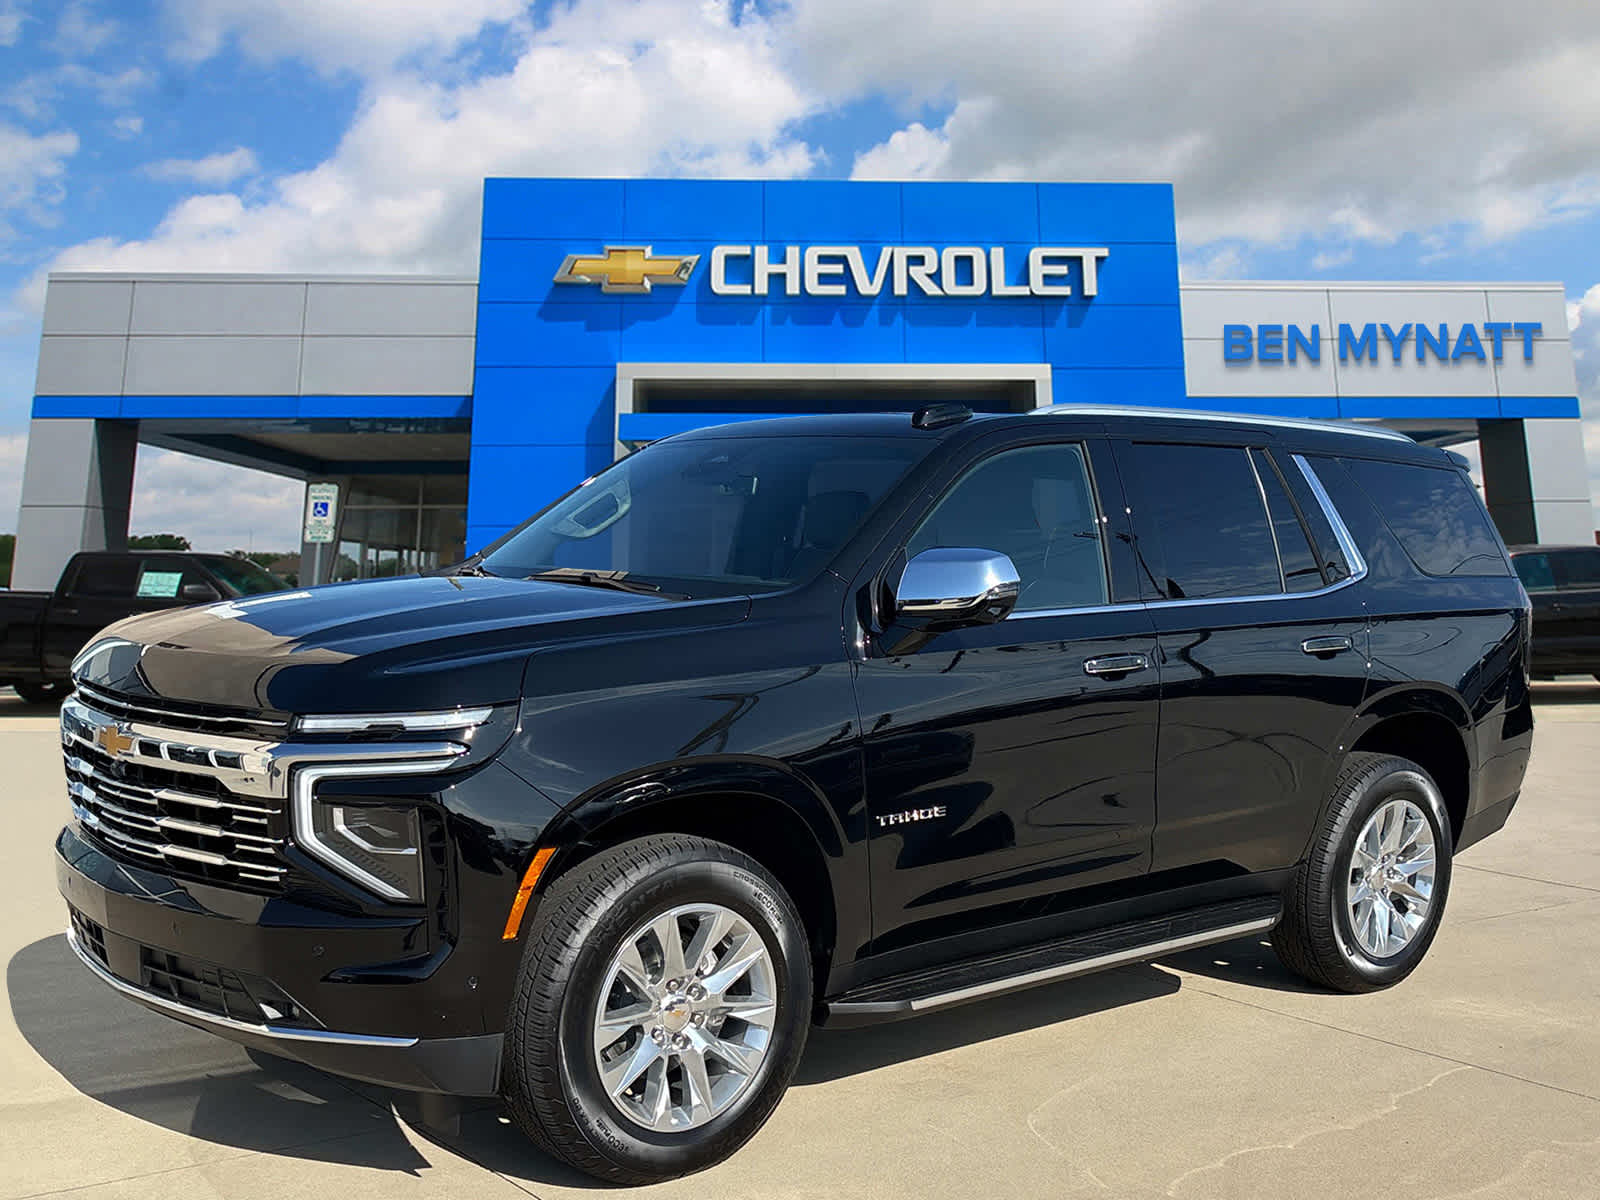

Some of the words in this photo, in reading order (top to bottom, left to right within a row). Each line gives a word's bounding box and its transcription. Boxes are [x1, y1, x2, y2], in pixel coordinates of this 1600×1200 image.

[710, 244, 1110, 297] CHEVROLET
[1223, 323, 1321, 362] BEN
[1338, 321, 1543, 362] MYNATT
[875, 805, 947, 827] TAHOE
